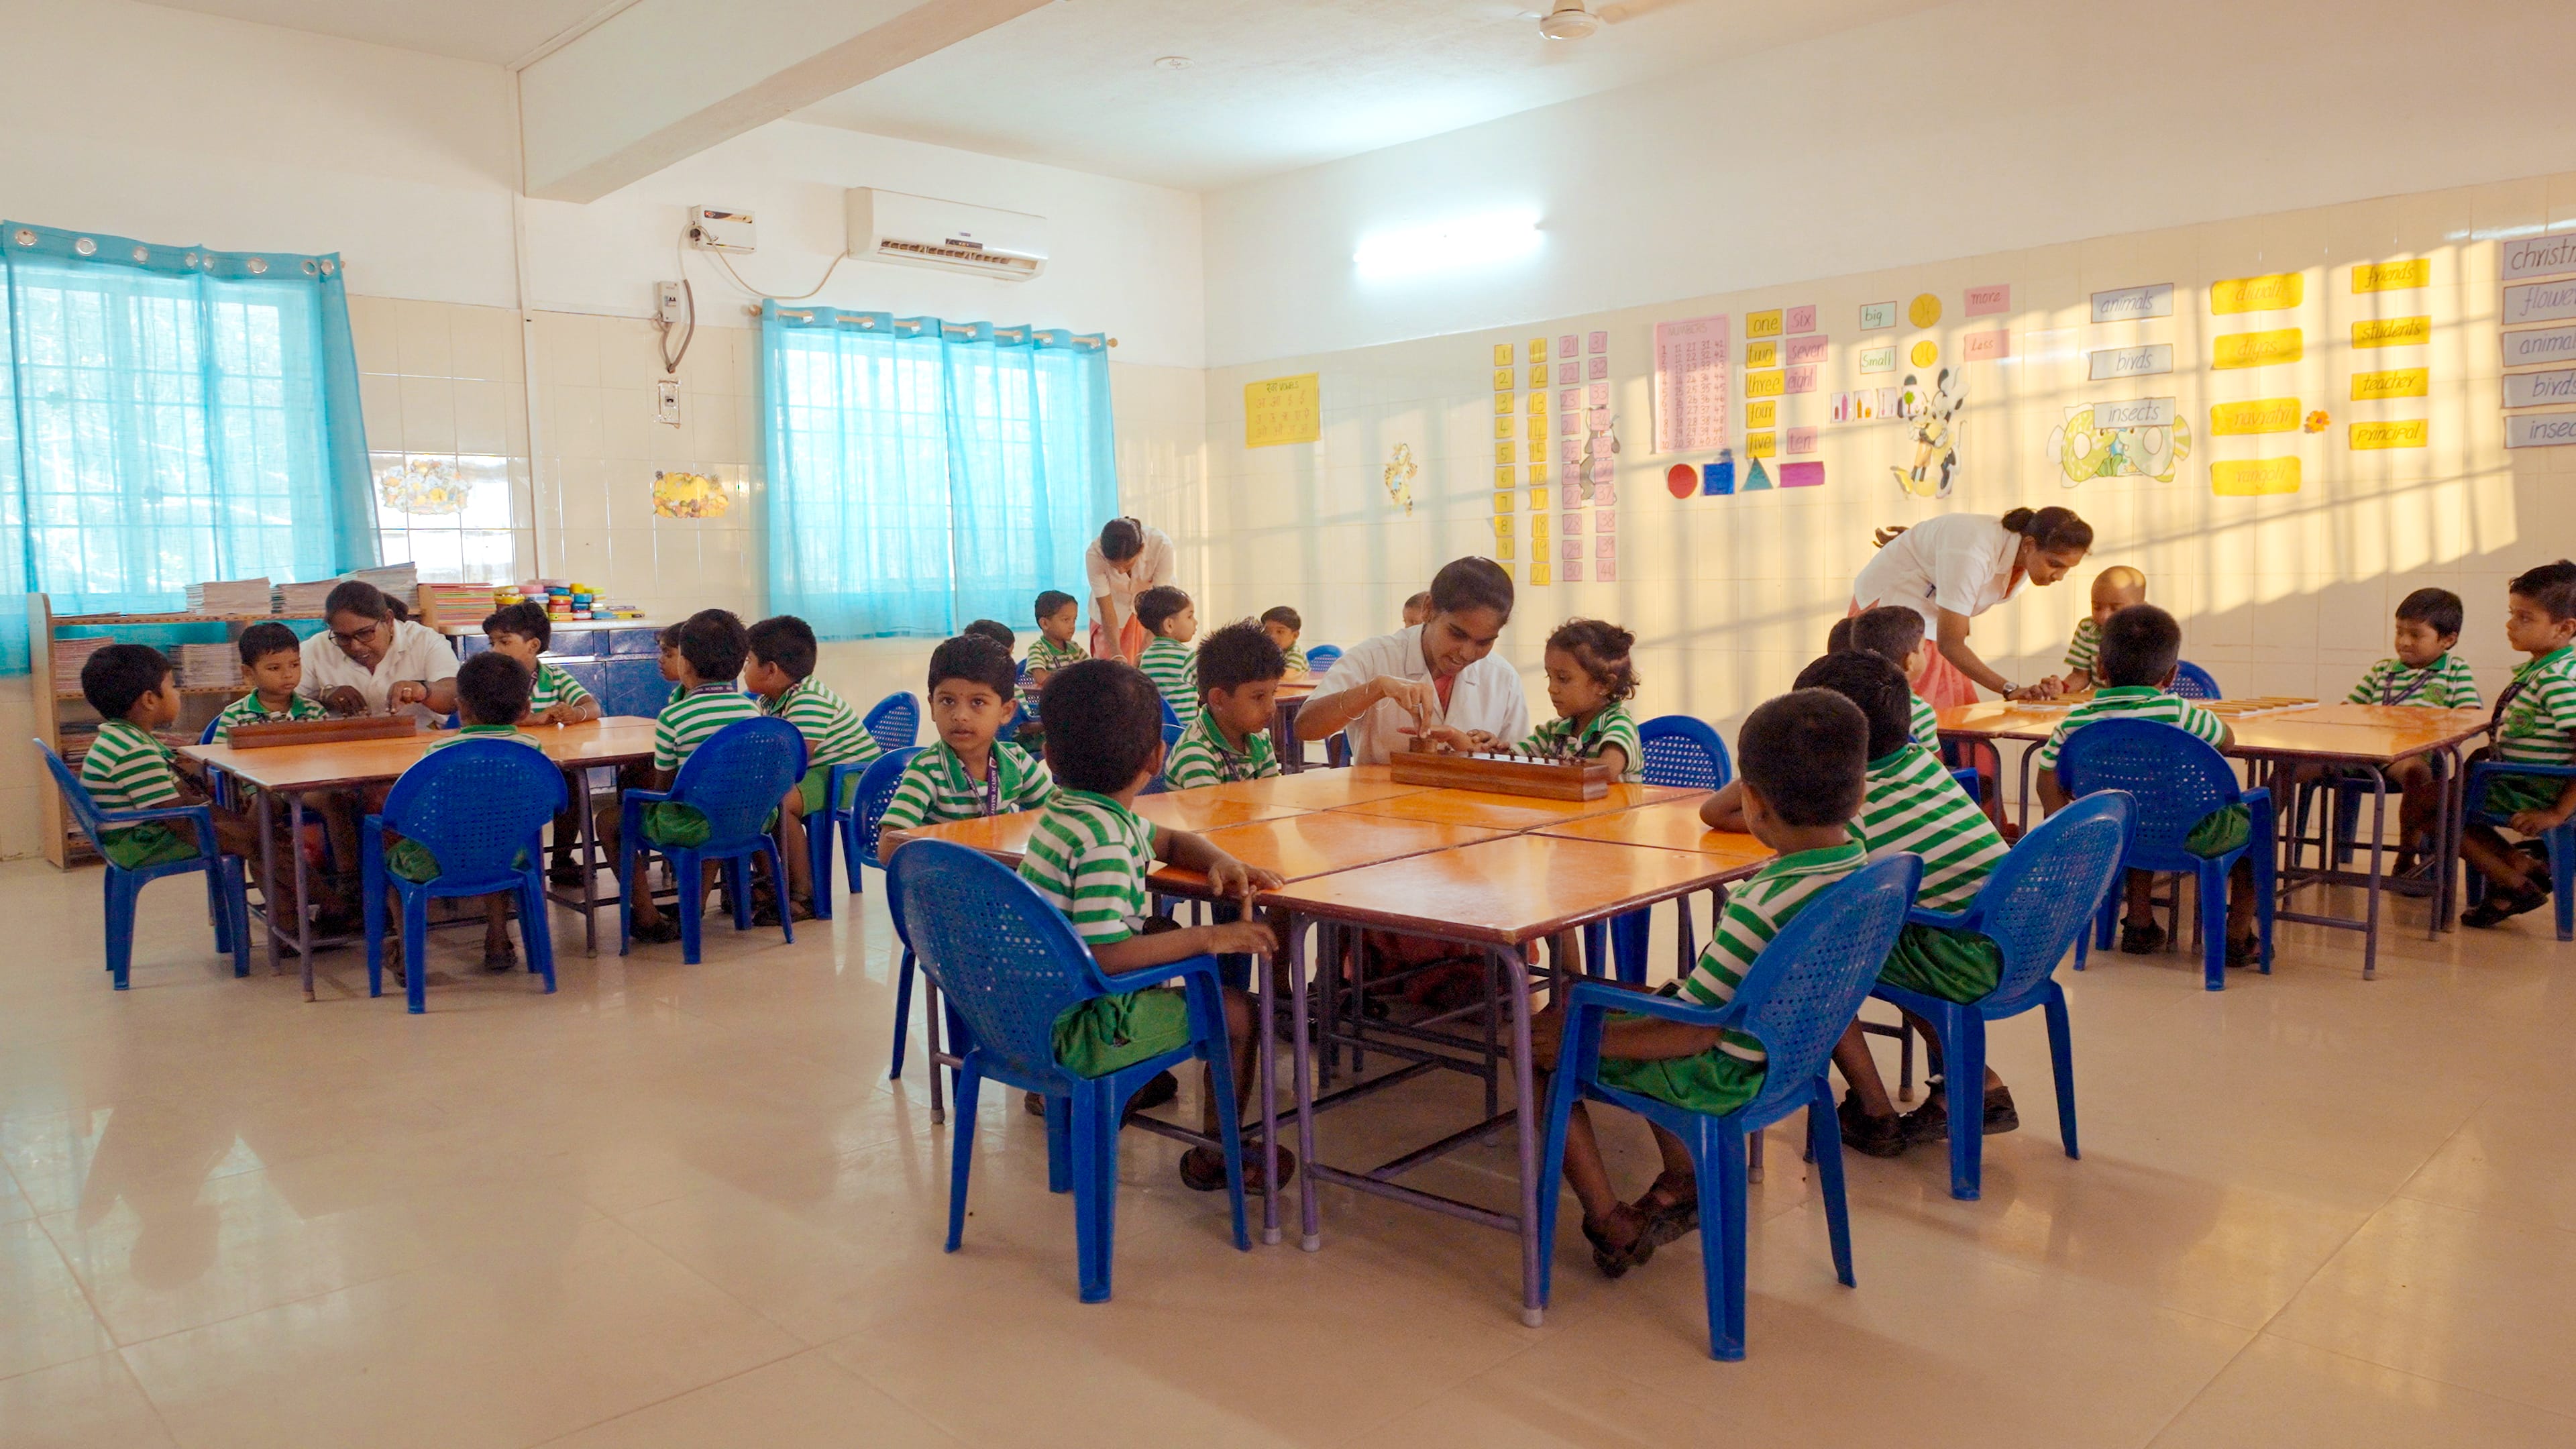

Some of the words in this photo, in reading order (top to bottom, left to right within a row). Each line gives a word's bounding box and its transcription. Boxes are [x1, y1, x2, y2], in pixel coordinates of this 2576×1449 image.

[2365, 262, 2414, 288] friends
[1971, 291, 2001, 305] more
[2236, 280, 2282, 301] diwali
[2100, 290, 2153, 313] animals
[2519, 286, 2576, 316] flowe
[1753, 317, 1778, 332] one
[1792, 311, 1811, 328] six
[1865, 307, 1882, 327] big
[2361, 318, 2420, 340] students
[1563, 339, 1575, 352] 21
[1592, 333, 1607, 350] 31
[1686, 342, 1696, 352] 21
[1701, 340, 1710, 350] 31
[2238, 337, 2277, 362] diyas
[1503, 350, 1506, 360] 1
[1532, 343, 1542, 361] 11
[1686, 353, 1696, 362] 22
[1749, 344, 1772, 364] two
[1790, 343, 1824, 360] seven
[1862, 351, 1891, 368] Small
[2116, 348, 2152, 371] birds
[1561, 367, 1576, 381] 22
[1591, 360, 1607, 374] 32
[1686, 362, 1697, 372] 23
[1498, 372, 1508, 384] 2
[1532, 366, 1546, 385] 12
[1748, 374, 1780, 392] three
[1788, 368, 1813, 392] eight
[2363, 370, 2417, 392] teacher
[1593, 385, 1607, 400] 33
[1686, 385, 1697, 394] 25
[1497, 394, 1507, 411] 3
[1532, 393, 1545, 411] 13
[1561, 392, 1576, 407] 23
[1686, 395, 1697, 404] 26
[1686, 405, 1697, 415] 27
[1701, 405, 1710, 414] 37
[1750, 404, 1773, 423] four
[2108, 400, 2160, 423] insects
[2235, 403, 2292, 425] navratri
[1500, 421, 1508, 433] 4
[1593, 411, 1608, 427] 34
[1686, 417, 1697, 426] 28
[1530, 418, 1546, 438] 14
[1595, 439, 1609, 453] 35
[1749, 435, 1772, 454] five
[1790, 433, 1811, 451] ten
[1501, 447, 1508, 461] 5
[1532, 443, 1544, 460] 15
[1562, 445, 1577, 459] 25
[1501, 472, 1506, 482] 6
[1534, 466, 1544, 483] 16
[2237, 464, 2286, 489] rangoli
[1534, 489, 1547, 508] 17
[1565, 490, 1580, 504] 27
[1597, 485, 1613, 500] 37
[1501, 496, 1507, 508] 7
[1501, 519, 1508, 532] 8
[1536, 515, 1546, 533] 18
[1565, 516, 1580, 531] 28
[1599, 512, 1615, 527] 38
[1503, 542, 1507, 555] 9
[1536, 540, 1547, 557] 19
[1566, 543, 1580, 558] 29
[1600, 537, 1614, 552] 39
[1567, 564, 1580, 577] 30
[1600, 562, 1615, 577] 40
